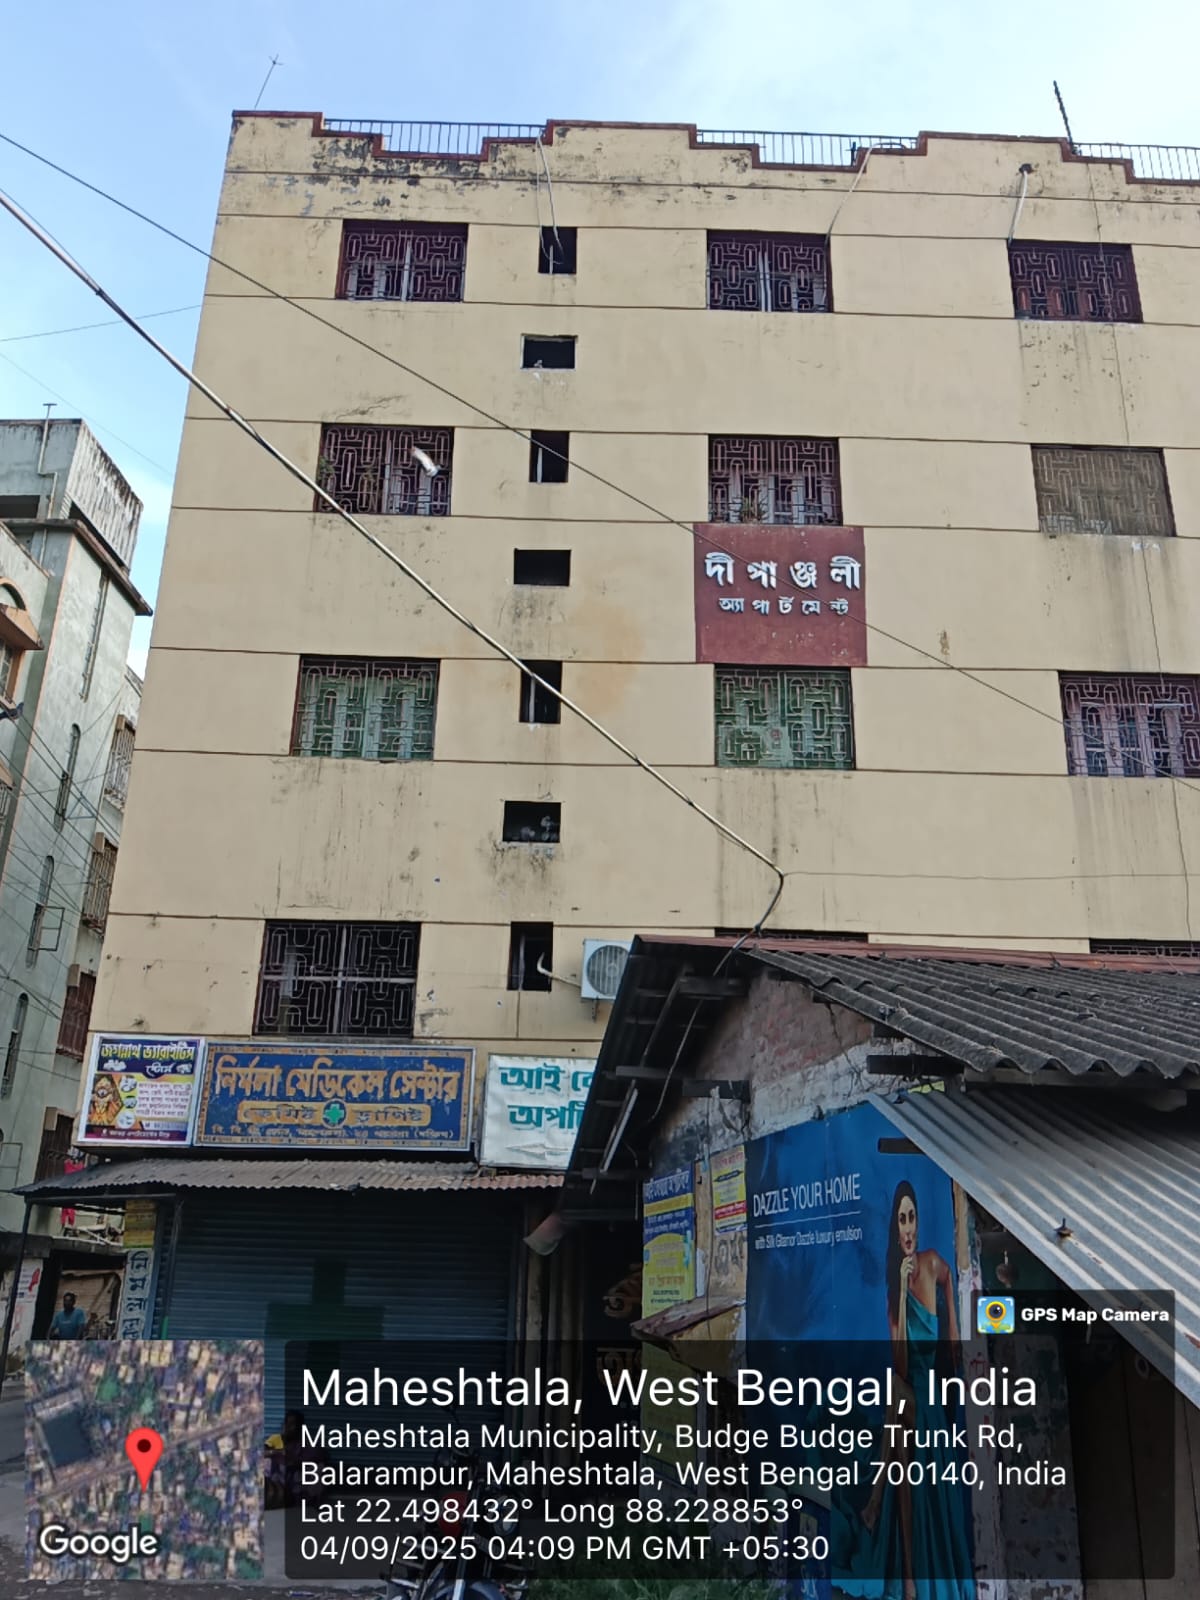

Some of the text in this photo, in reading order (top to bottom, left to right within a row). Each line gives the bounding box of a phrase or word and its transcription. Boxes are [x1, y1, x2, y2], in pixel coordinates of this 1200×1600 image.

[214, 1054, 461, 1103] নির্মলা মেডিকেল সেন্টার
[498, 1062, 565, 1091] আই
[753, 1188, 790, 1217] DAZZLE
[791, 1181, 824, 1210] YOUR
[824, 1173, 861, 1205] HOME
[755, 1235, 765, 1250] with
[797, 1231, 815, 1246] Dazzle
[836, 1225, 863, 1242] emulsion
